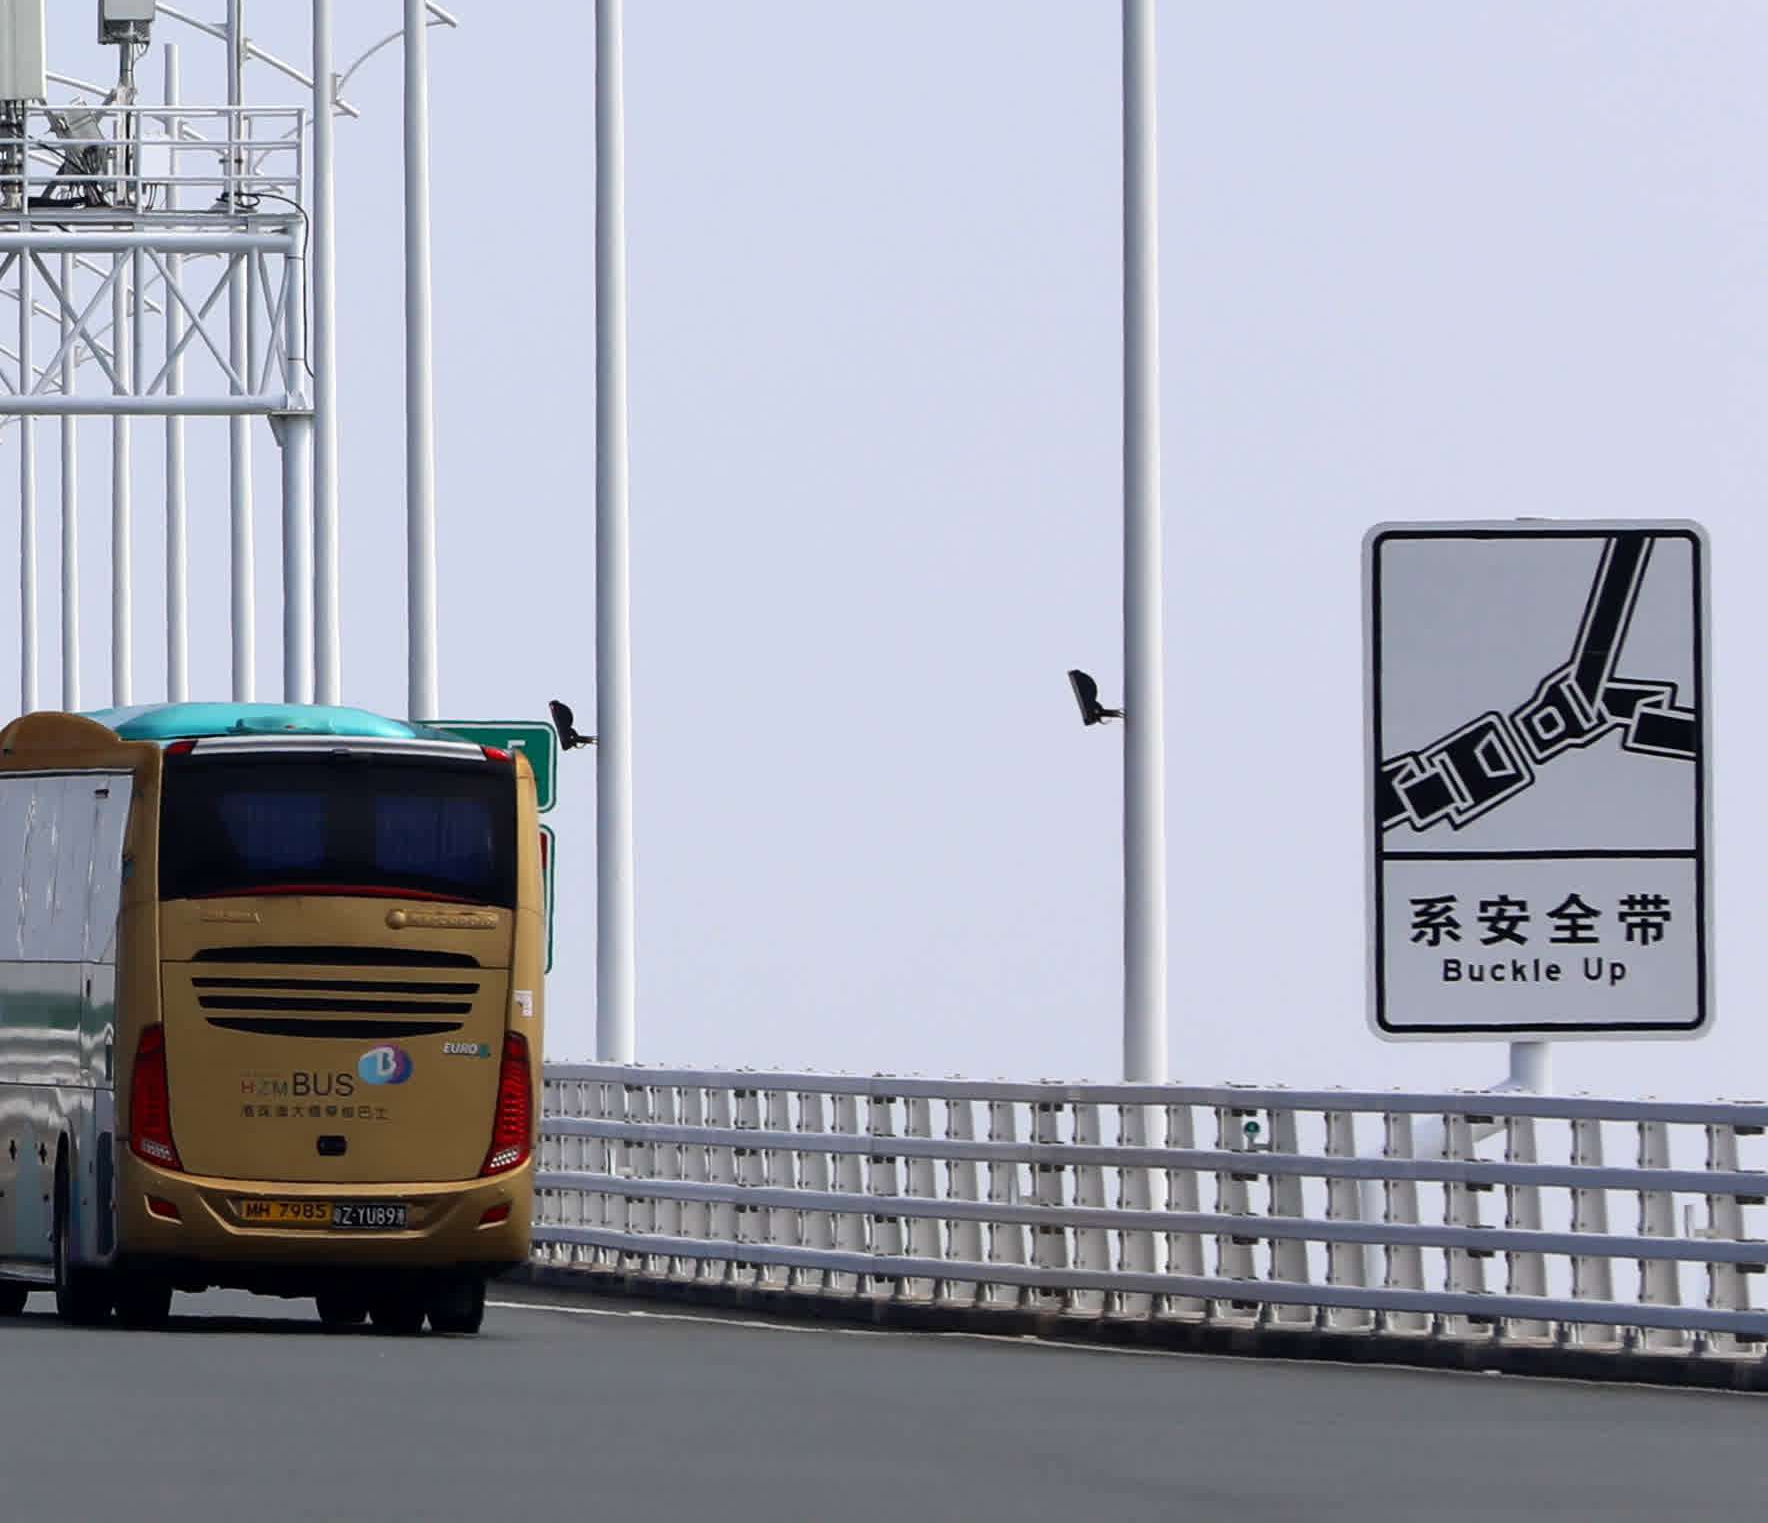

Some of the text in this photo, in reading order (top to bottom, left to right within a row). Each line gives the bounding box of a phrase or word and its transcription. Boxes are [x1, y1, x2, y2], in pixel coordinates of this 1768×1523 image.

[1409, 892, 1672, 947] 系安全带
[1442, 956, 1627, 987] Buckle Up
